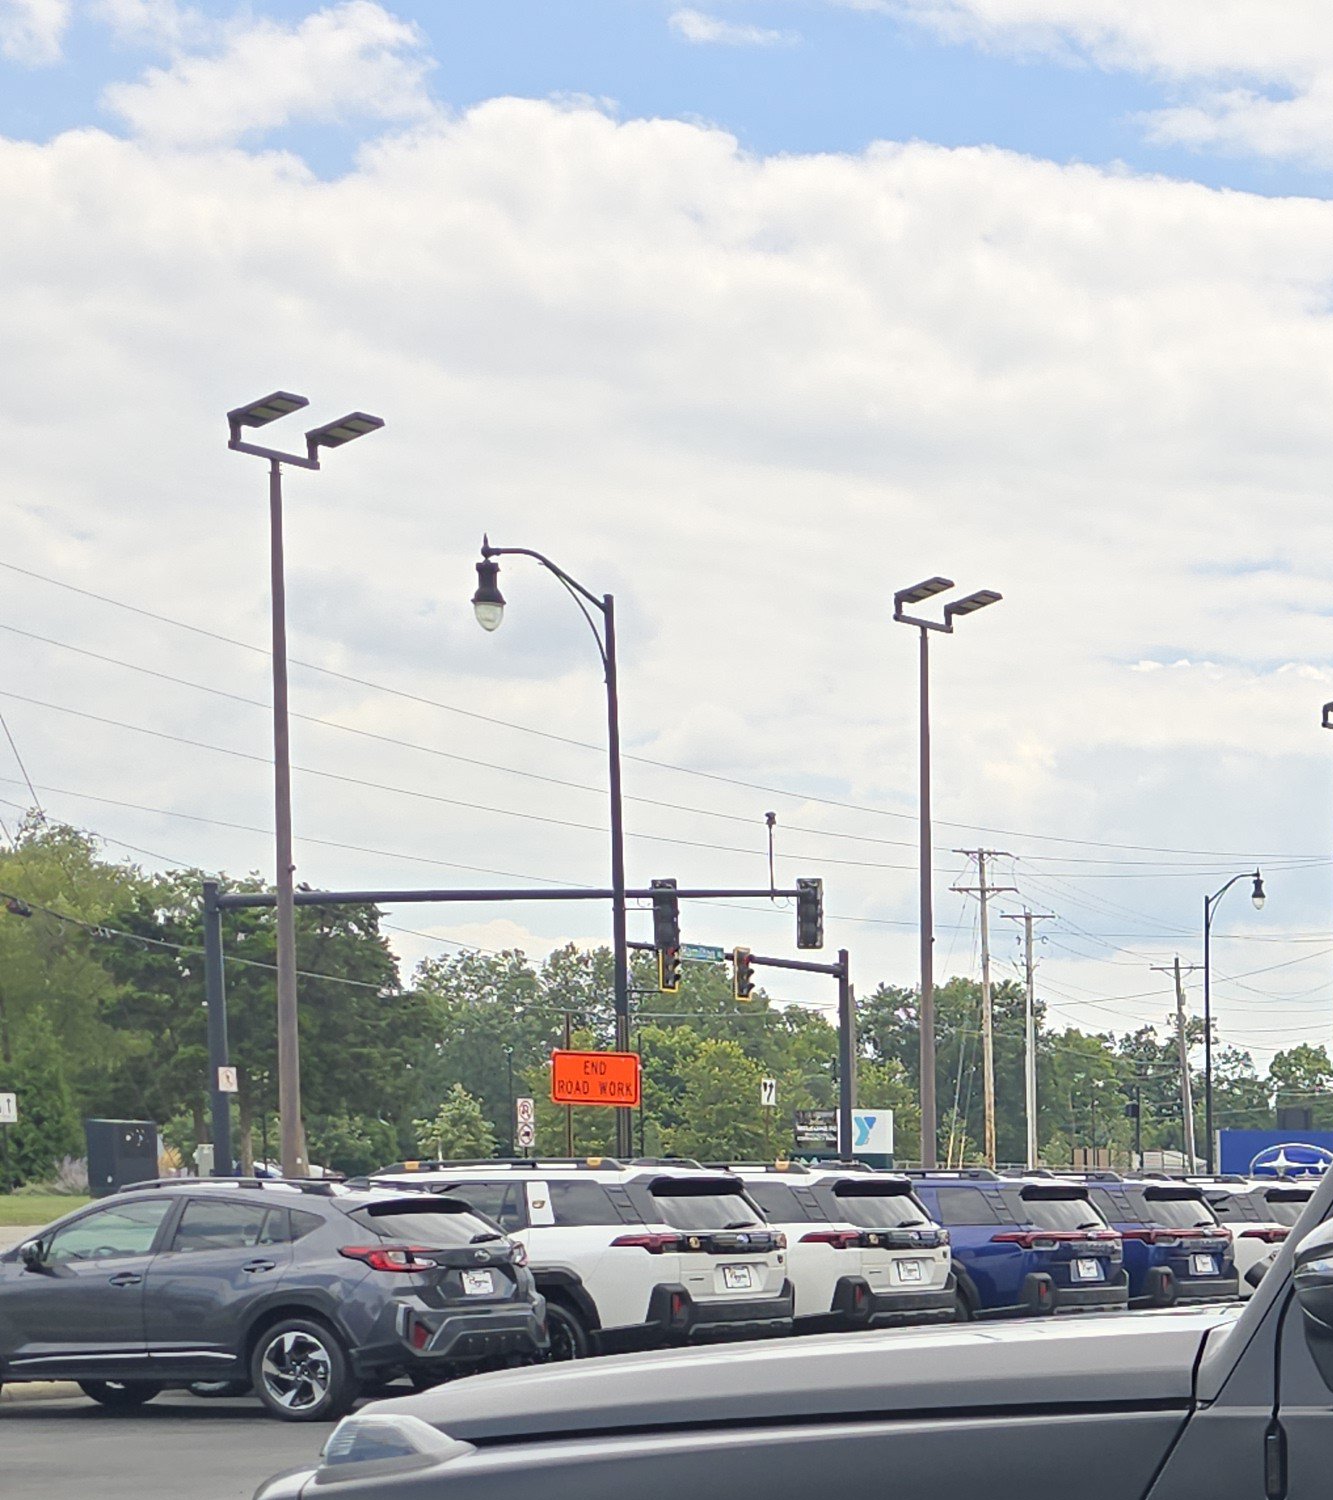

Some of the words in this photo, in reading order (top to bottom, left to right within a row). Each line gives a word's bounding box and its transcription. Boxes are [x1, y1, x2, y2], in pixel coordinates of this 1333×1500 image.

[583, 1061, 607, 1075] END
[558, 1079, 590, 1095] ROAD
[599, 1080, 633, 1097] WORK
